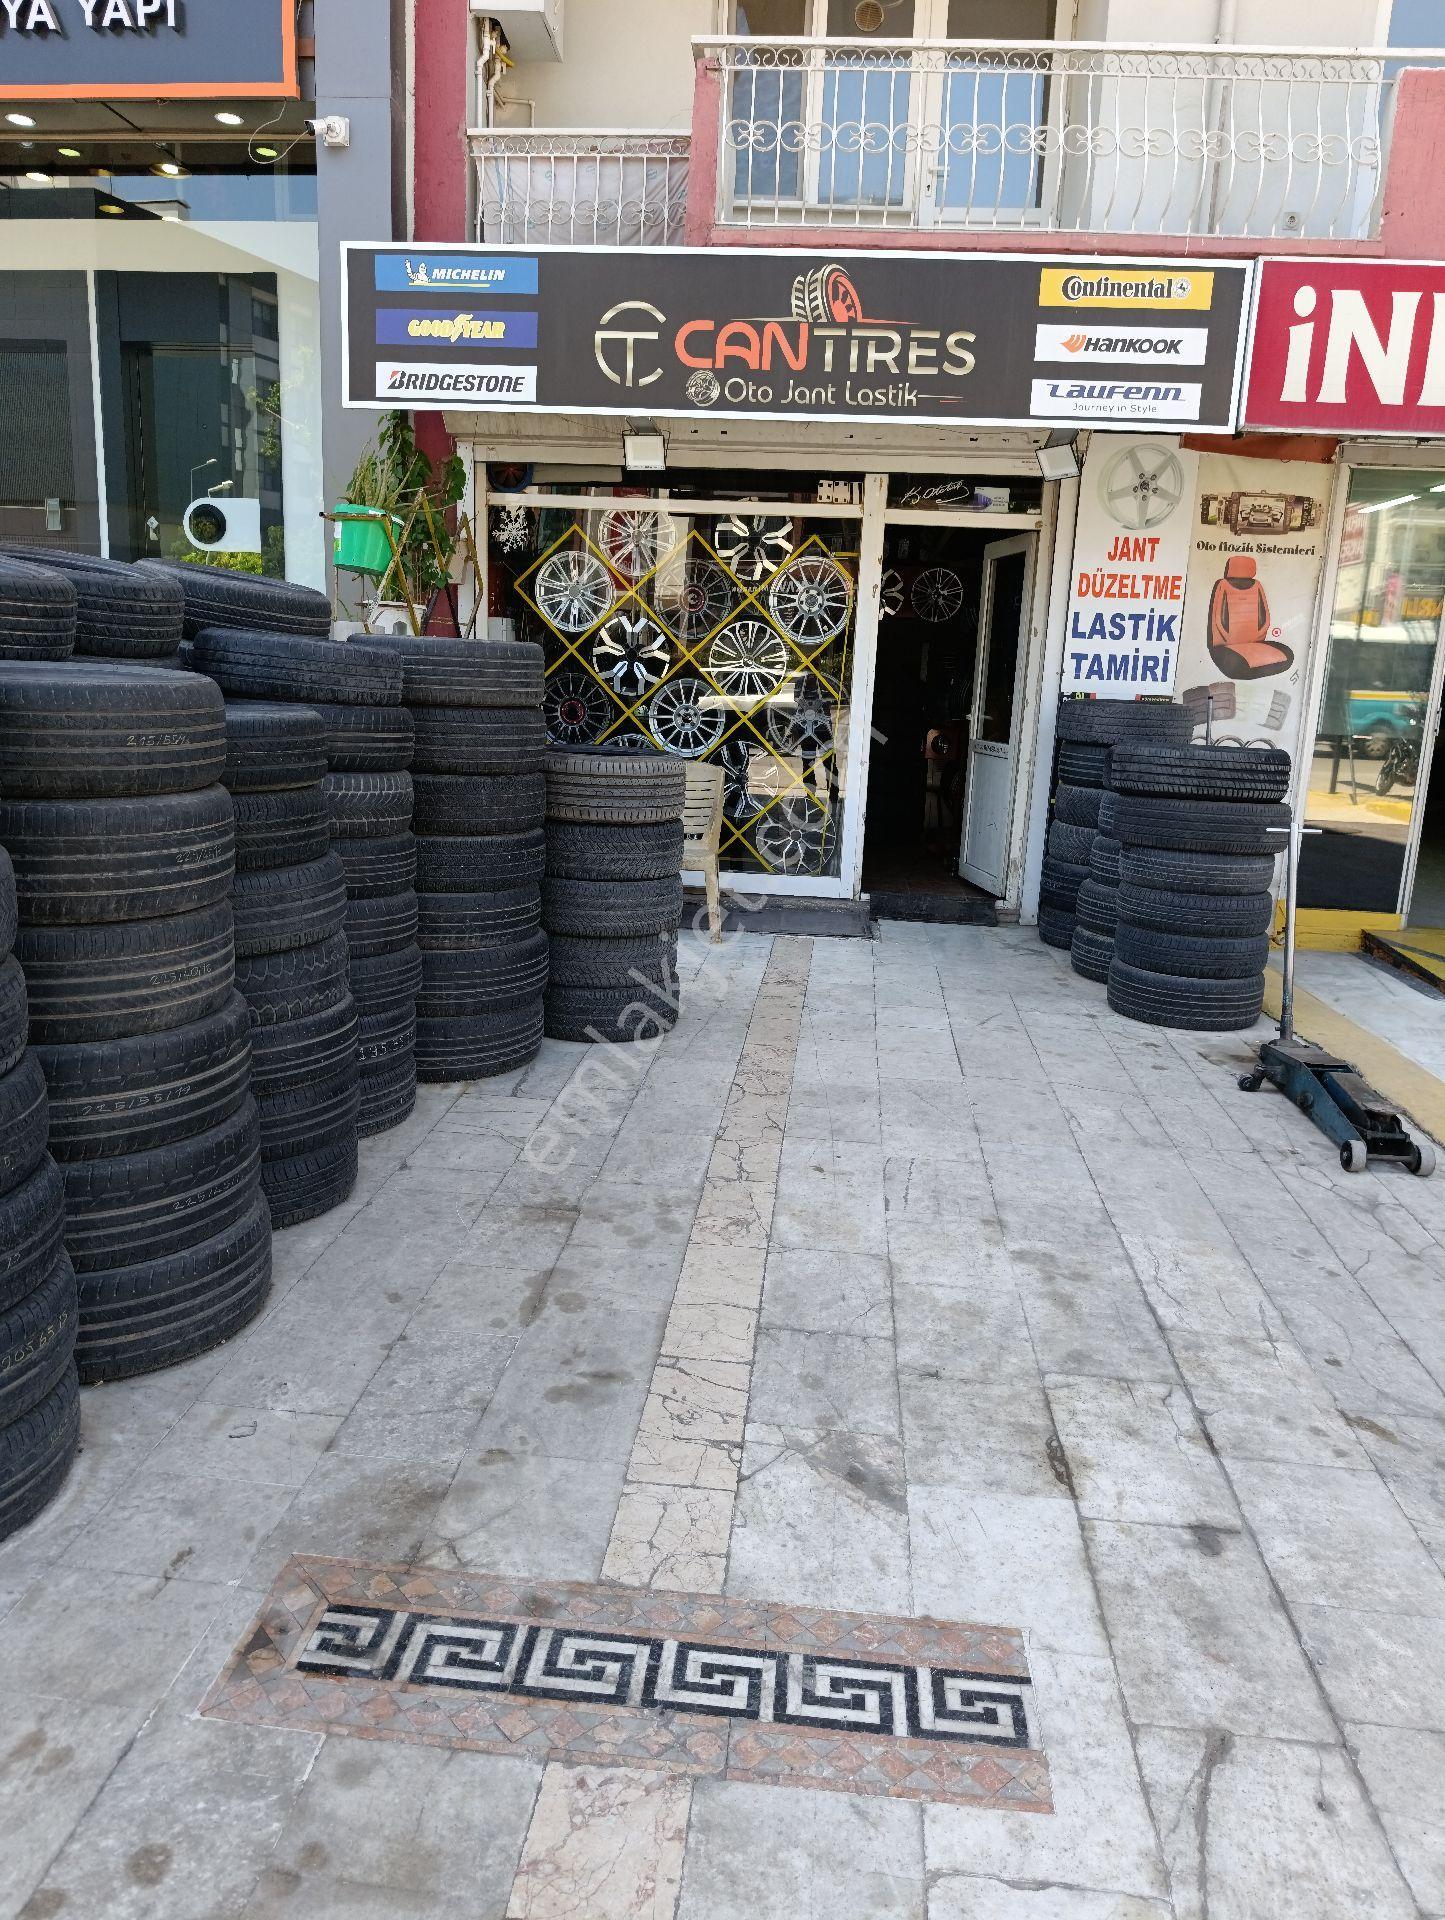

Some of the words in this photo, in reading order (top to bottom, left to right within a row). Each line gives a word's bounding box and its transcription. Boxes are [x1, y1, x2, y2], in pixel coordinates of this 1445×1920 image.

[431, 268, 506, 281] MICHELIN
[1061, 275, 1174, 301] Continental
[1279, 285, 1445, 407] iN
[386, 370, 526, 393] BRIDGESTONE
[724, 377, 773, 403] Oto
[780, 380, 836, 405] Jant
[845, 380, 918, 407] Lastik
[1072, 402, 1116, 414] Journey
[1117, 404, 1127, 413] in
[1129, 404, 1158, 415] Style
[1107, 536, 1161, 562] JANT
[1255, 543, 1316, 556] Sistemleri
[1077, 567, 1183, 600] DÜZELTME
[1071, 607, 1178, 643] LASTİK
[1070, 648, 1170, 683] TAMİRİ
